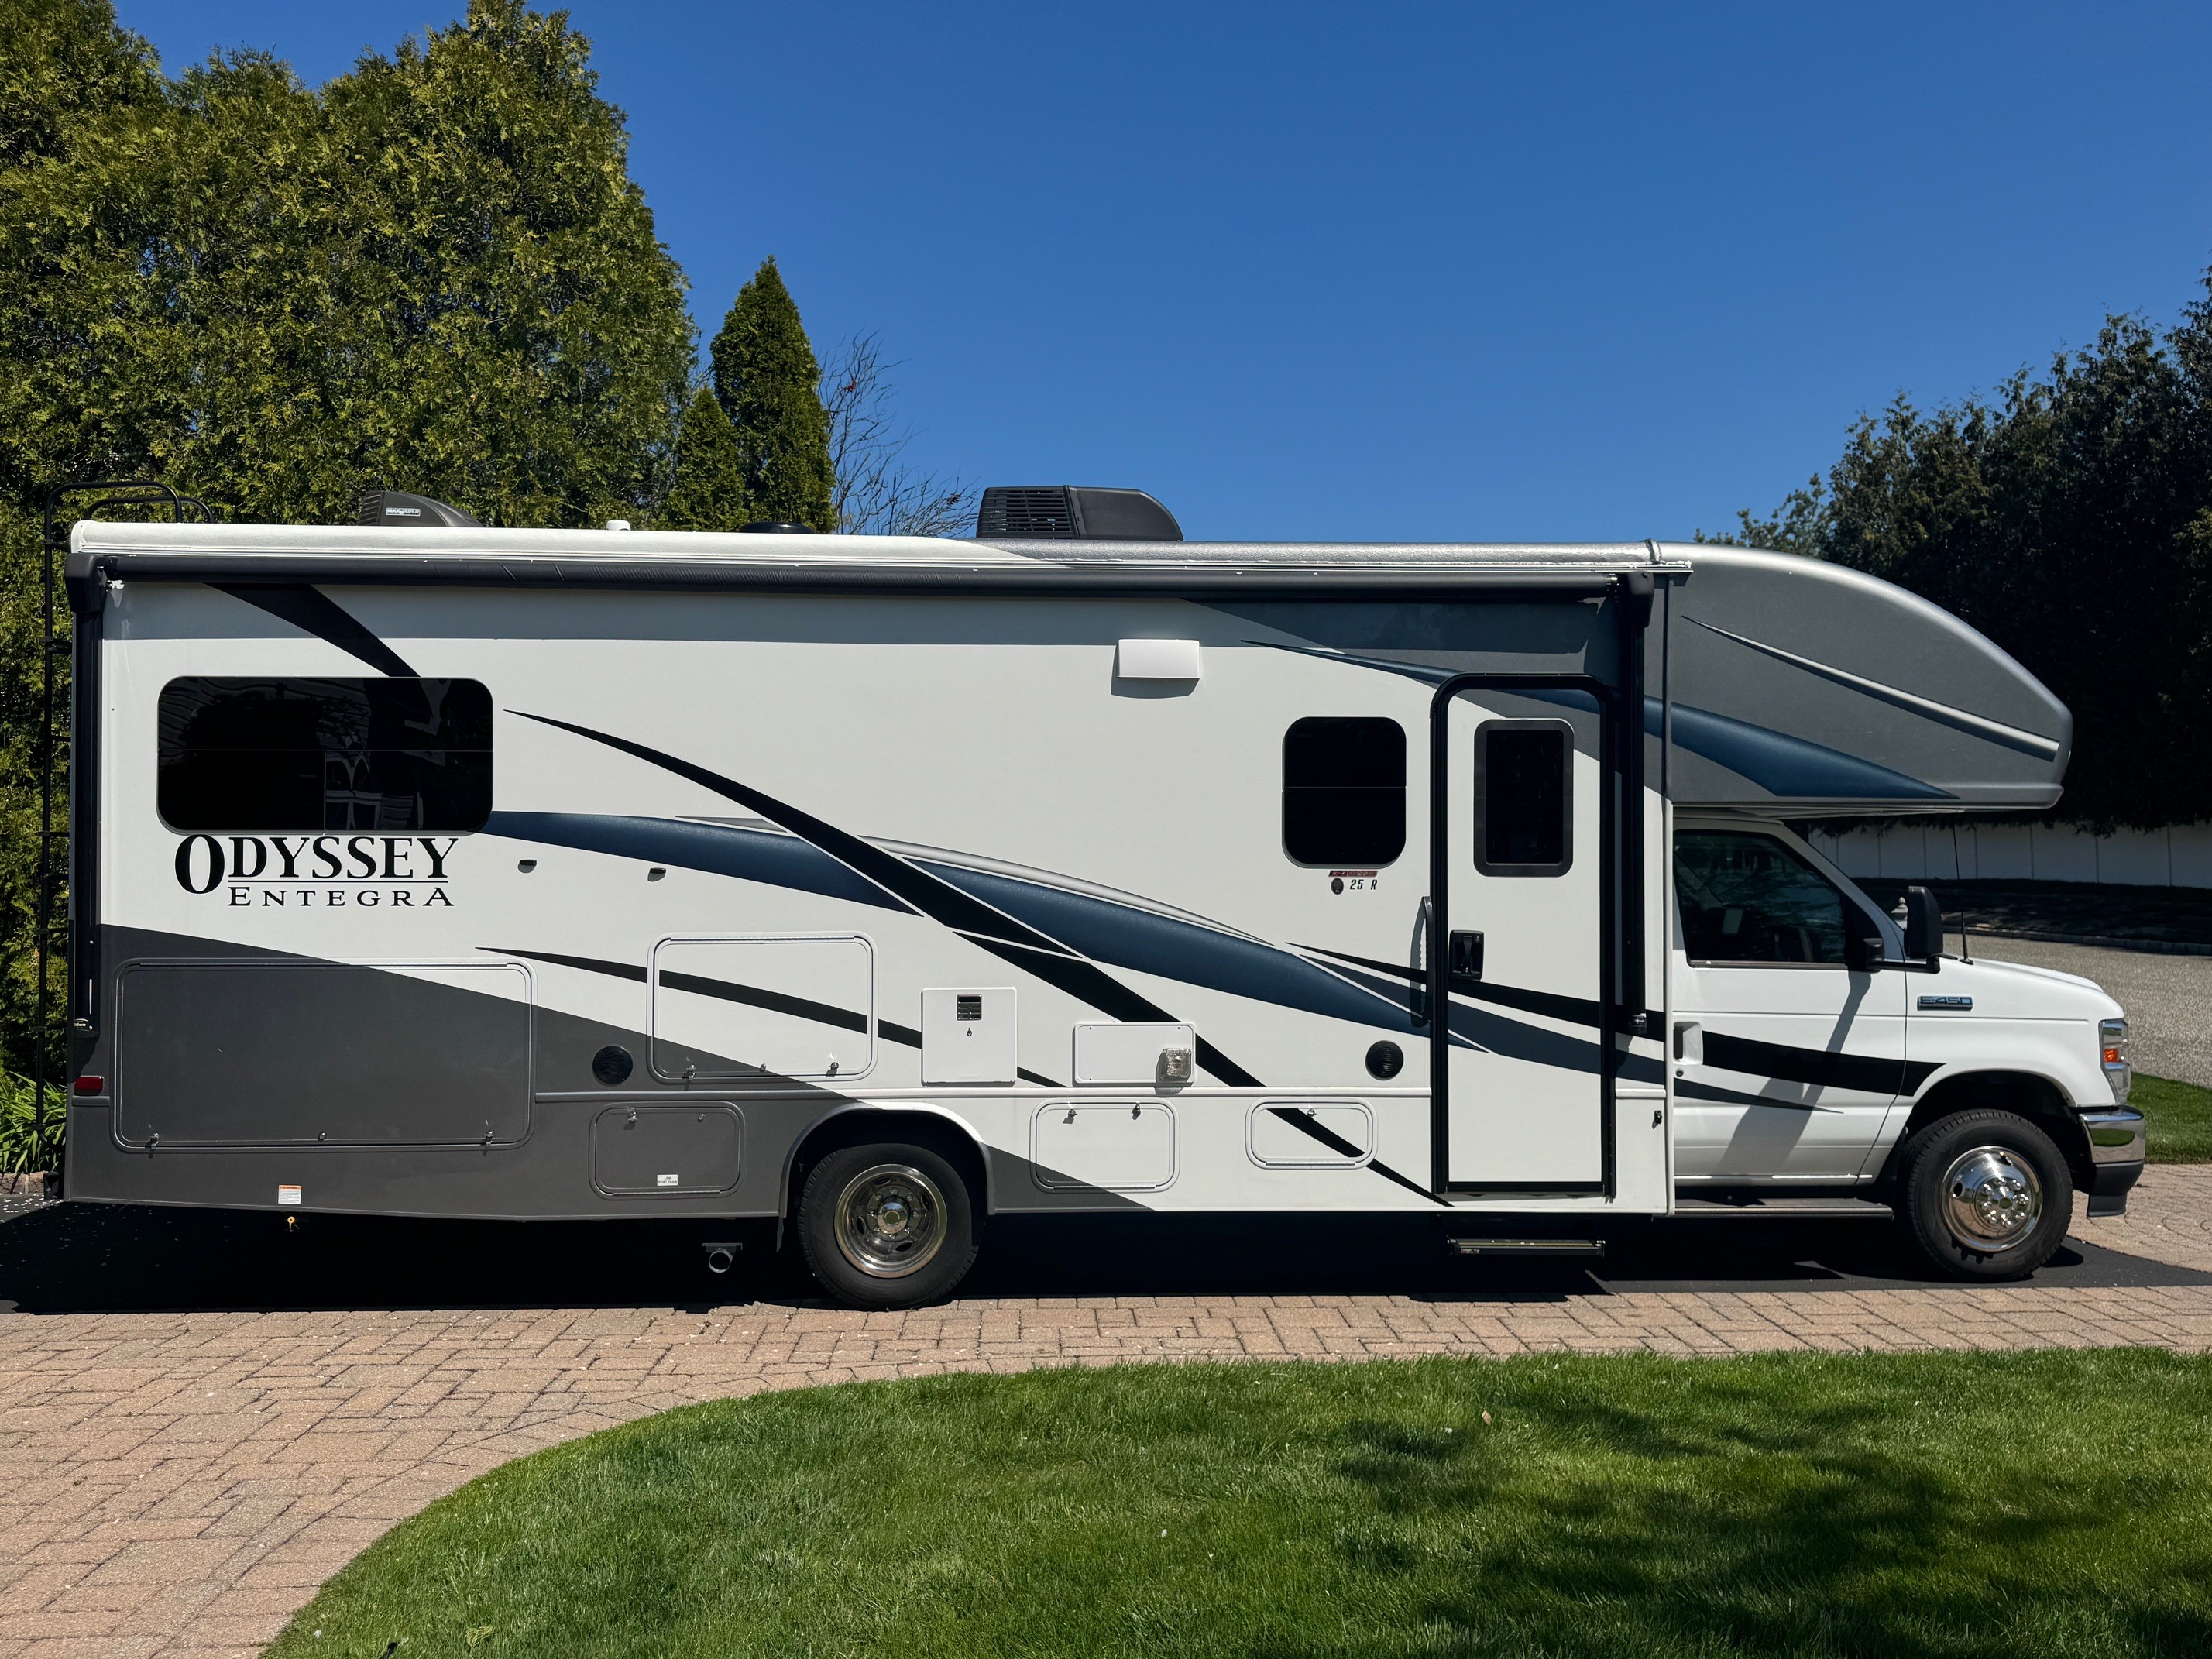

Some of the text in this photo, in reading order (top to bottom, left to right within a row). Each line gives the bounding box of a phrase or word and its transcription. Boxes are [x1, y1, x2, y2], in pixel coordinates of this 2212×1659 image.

[175, 834, 459, 894] ODYSSEY
[1349, 879, 1364, 890] 25
[1370, 879, 1378, 890] R
[228, 886, 454, 907] ENTEGRA
